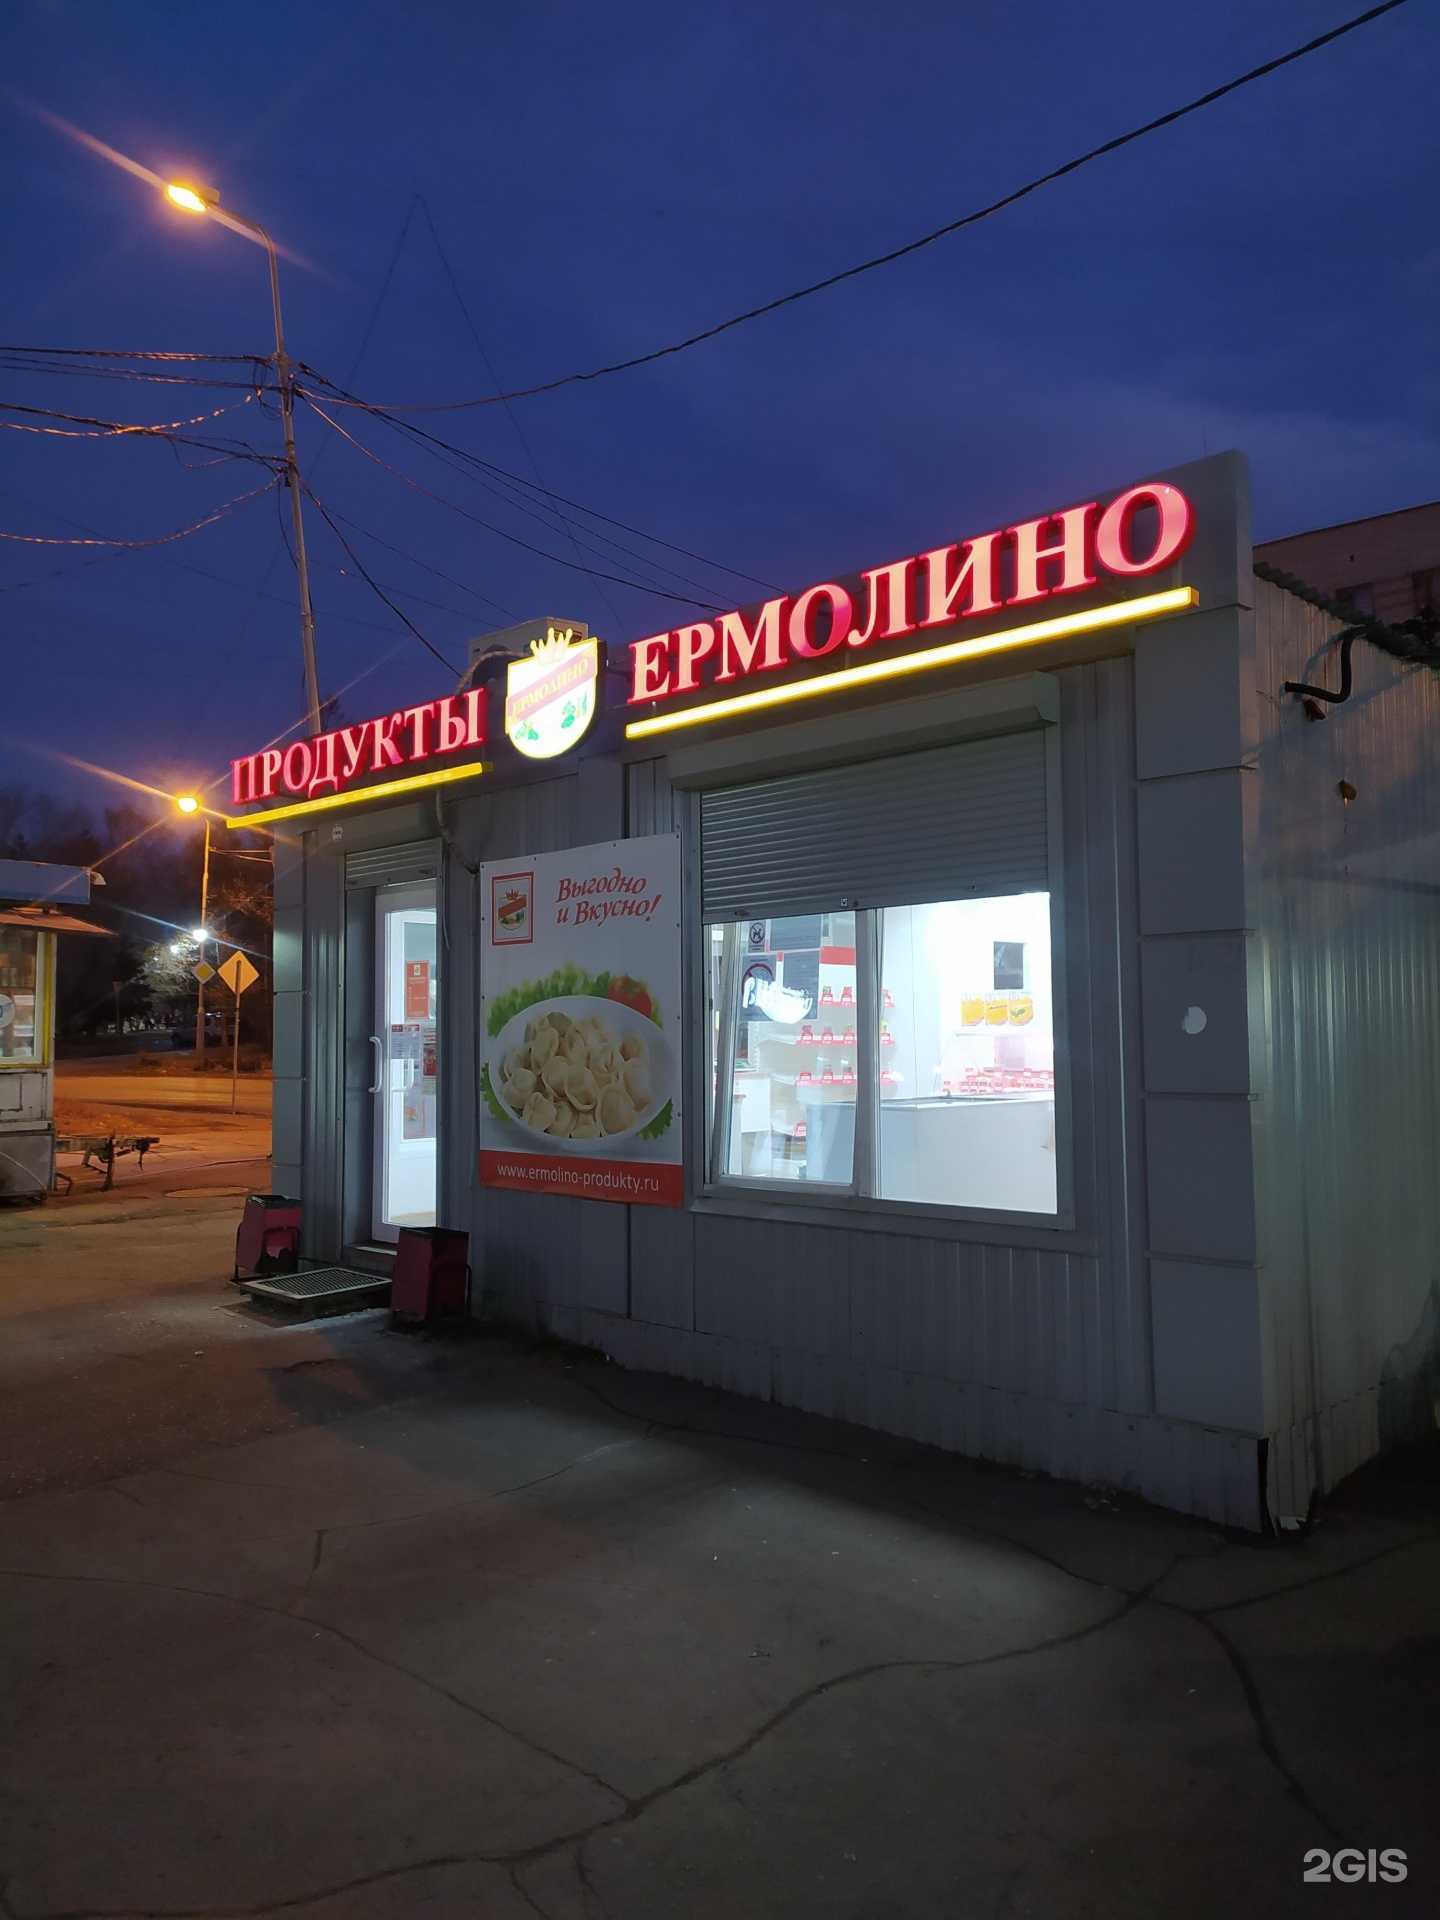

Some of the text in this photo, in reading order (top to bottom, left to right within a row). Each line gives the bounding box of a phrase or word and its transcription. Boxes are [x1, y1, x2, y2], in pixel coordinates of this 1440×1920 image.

[628, 482, 1193, 703] ЕРМОЛИНО
[231, 687, 487, 804] ПРОДУКТЫ
[555, 867, 647, 903] Выгодно
[556, 894, 662, 927] и Вкусно!
[496, 1163, 660, 1194] www.ermolino-produkty.ru
